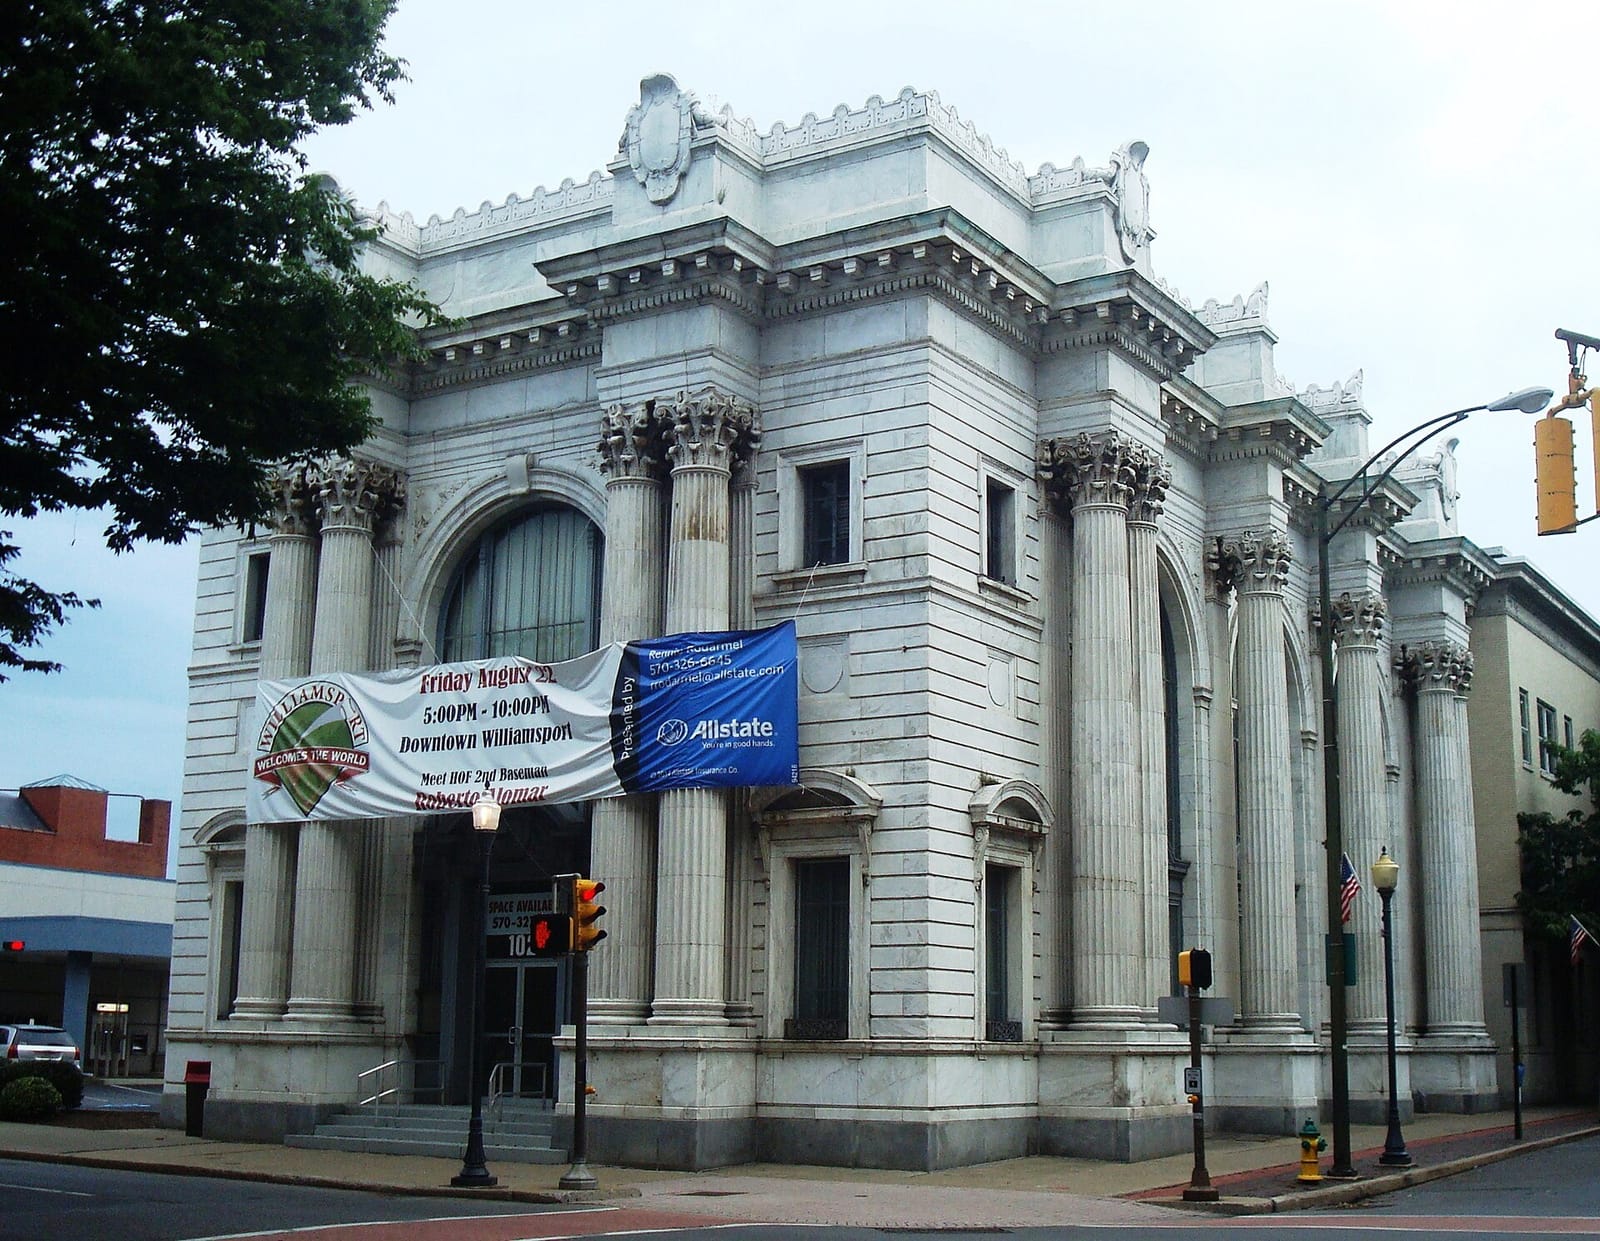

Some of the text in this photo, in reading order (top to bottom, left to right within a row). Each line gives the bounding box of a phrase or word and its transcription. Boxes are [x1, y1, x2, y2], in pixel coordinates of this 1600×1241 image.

[420, 672, 473, 694] Friday
[535, 665, 558, 683] 22
[621, 676, 635, 694] by
[423, 702, 477, 725] 5:00PM
[492, 695, 551, 719] 10:00PM
[399, 721, 573, 753] Downtown Williamsport
[689, 717, 773, 740] Allstate
[733, 740, 751, 749] good
[257, 750, 367, 771] WELCOMES THE WORLD
[420, 765, 549, 786] Meet HOF 2nd Baseman
[414, 789, 481, 811] Roberto
[488, 901, 513, 914] SPACE
